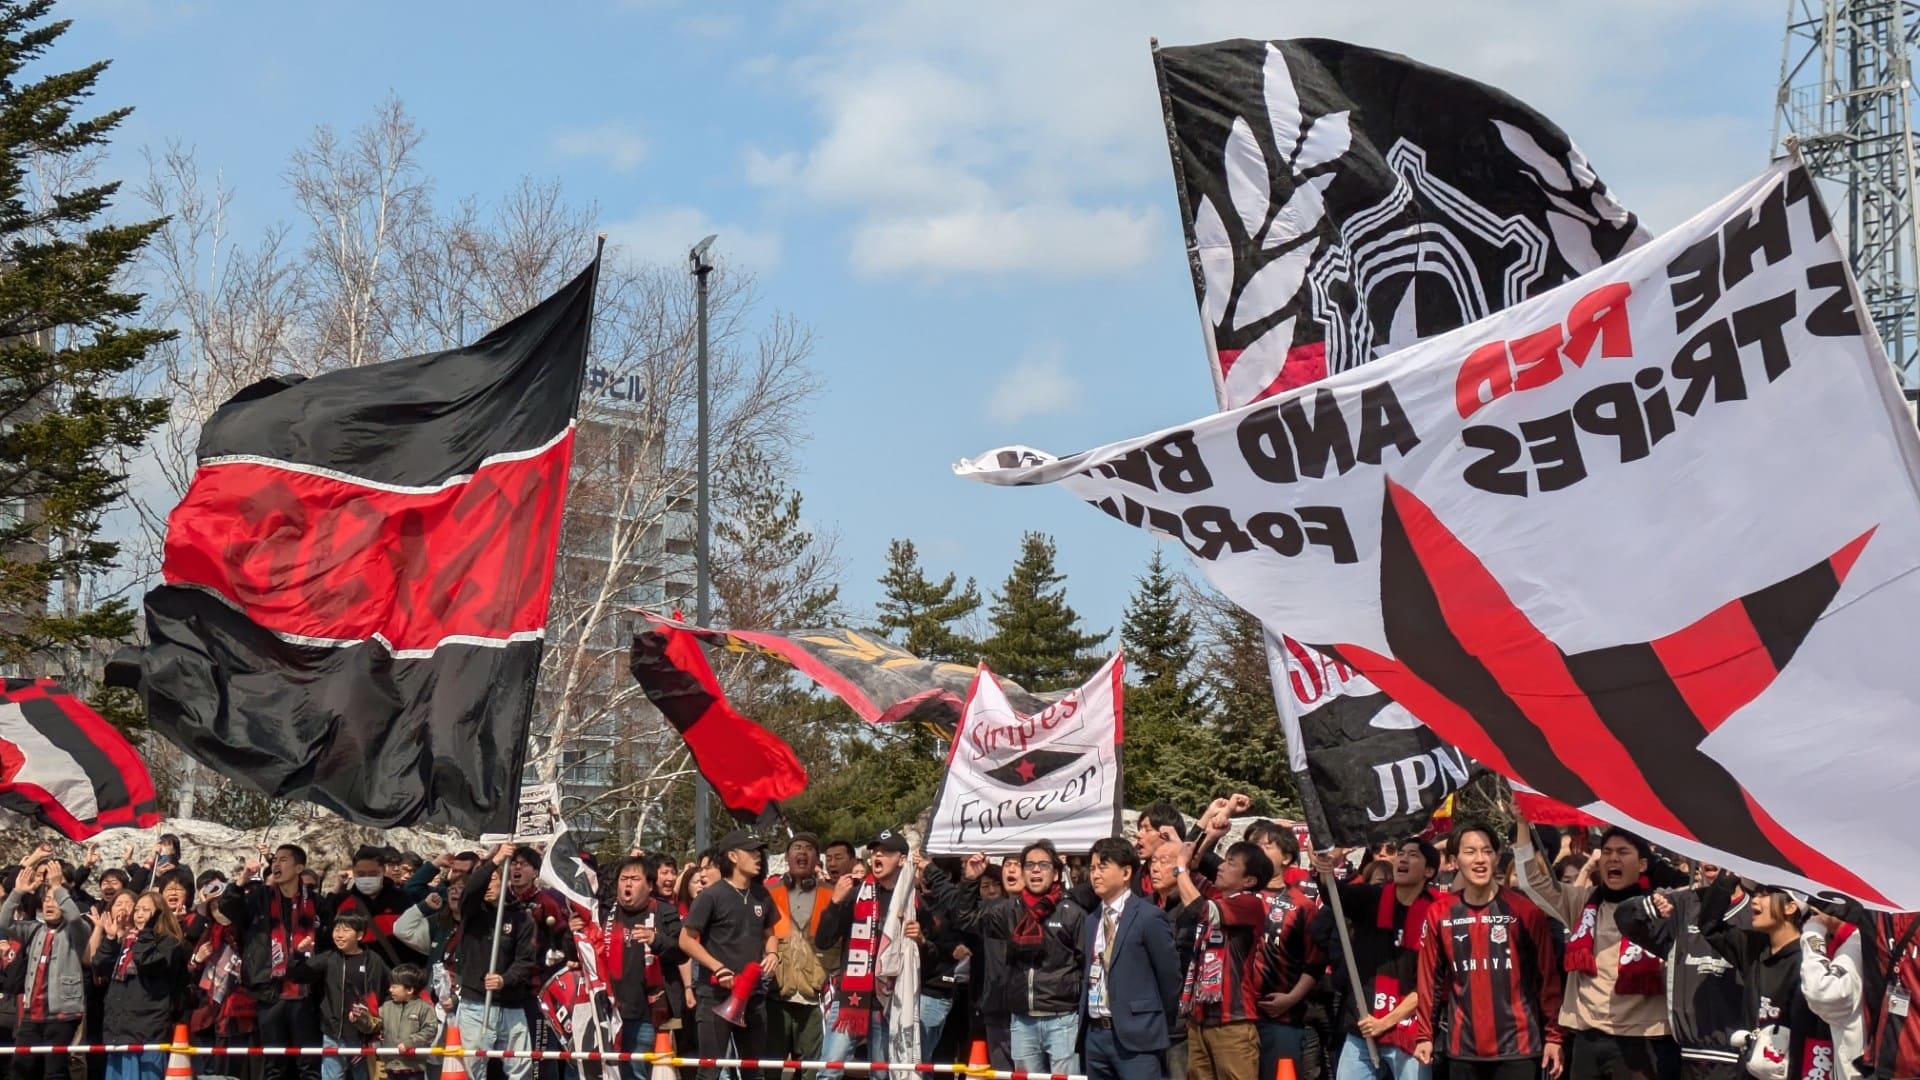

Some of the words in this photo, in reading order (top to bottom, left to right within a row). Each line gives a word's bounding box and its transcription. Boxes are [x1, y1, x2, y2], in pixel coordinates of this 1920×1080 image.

[584, 366, 647, 402] 井ビル
[971, 692, 1079, 761] Stripes
[957, 765, 1097, 845] Forever
[1366, 746, 1470, 822] JPN
[1452, 955, 1513, 972] ISHIYA
